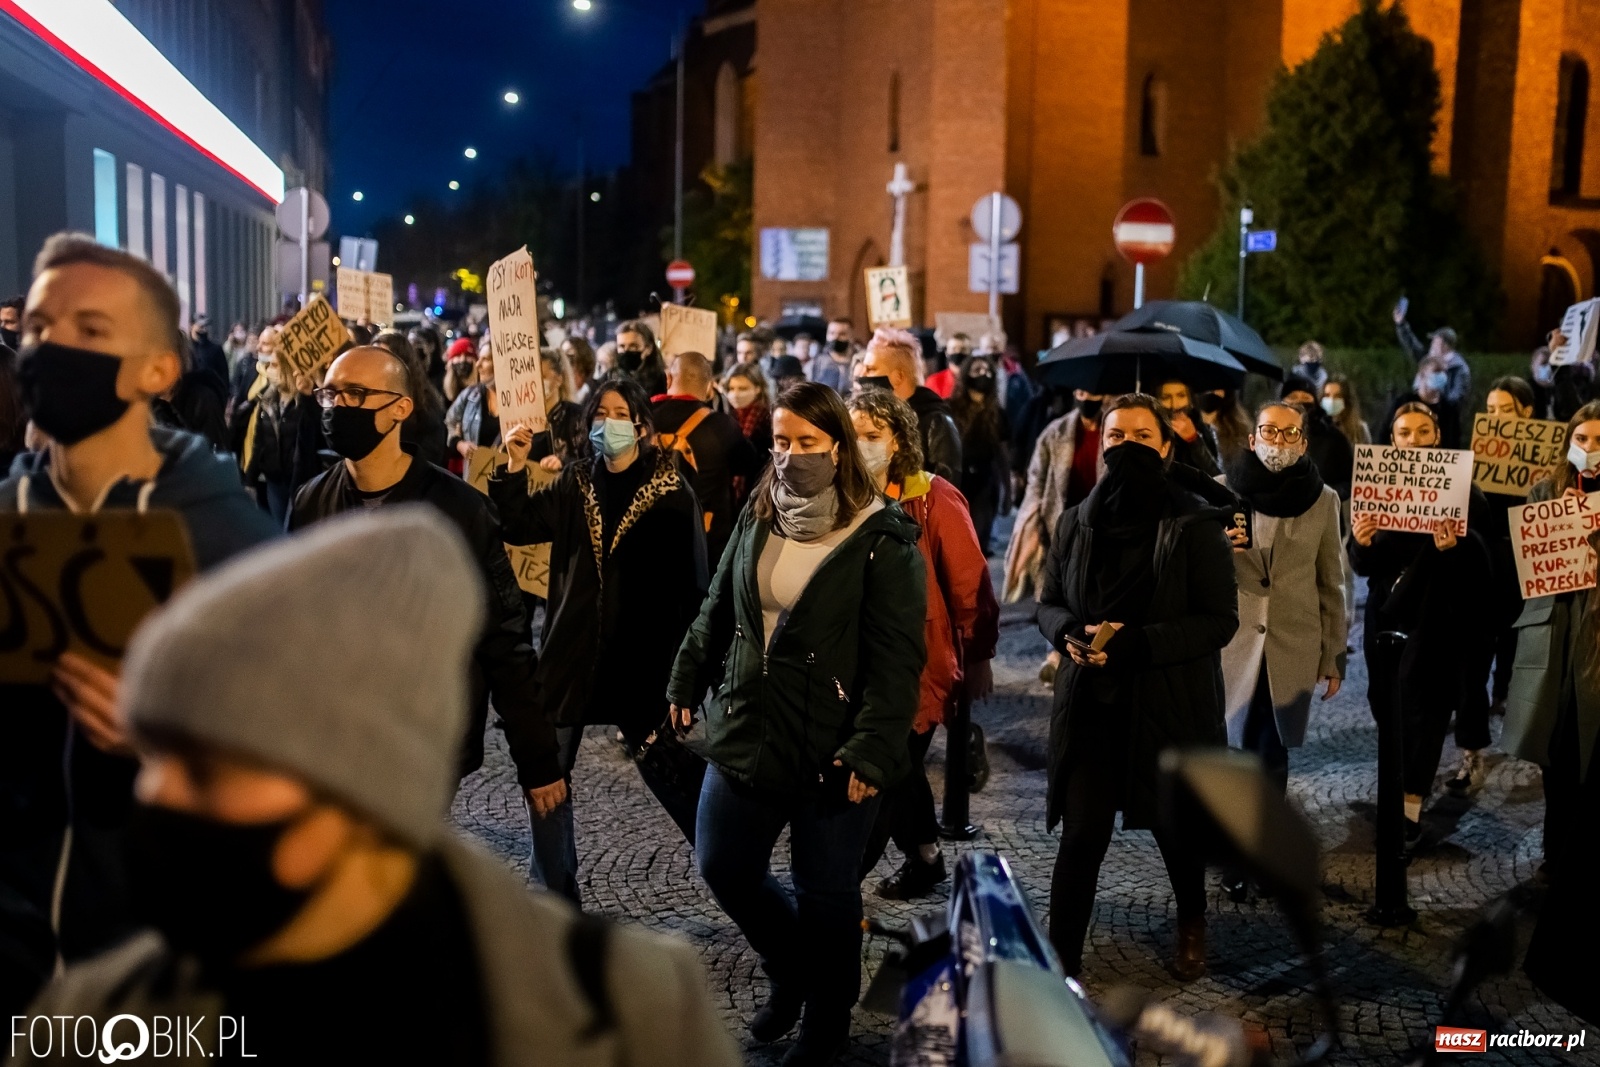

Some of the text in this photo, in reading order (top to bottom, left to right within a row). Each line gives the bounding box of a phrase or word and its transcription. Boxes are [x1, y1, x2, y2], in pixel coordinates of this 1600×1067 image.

[291, 325, 334, 375] KOBIET
[510, 356, 536, 381] PRAWA
[501, 380, 537, 408] OD NAS
[1475, 418, 1547, 442] CHCESZ
[1357, 448, 1373, 458] NA
[1355, 473, 1397, 485] NAGIE
[1356, 462, 1373, 471] NA
[1379, 462, 1416, 475] DOLE
[1473, 460, 1530, 488] TYLKO
[1353, 486, 1438, 502] POLSKA TO
[1353, 500, 1461, 518] JEDNO WIELKIE
[1522, 496, 1591, 523] GODEK
[1525, 569, 1597, 597] PRZEŚLA
